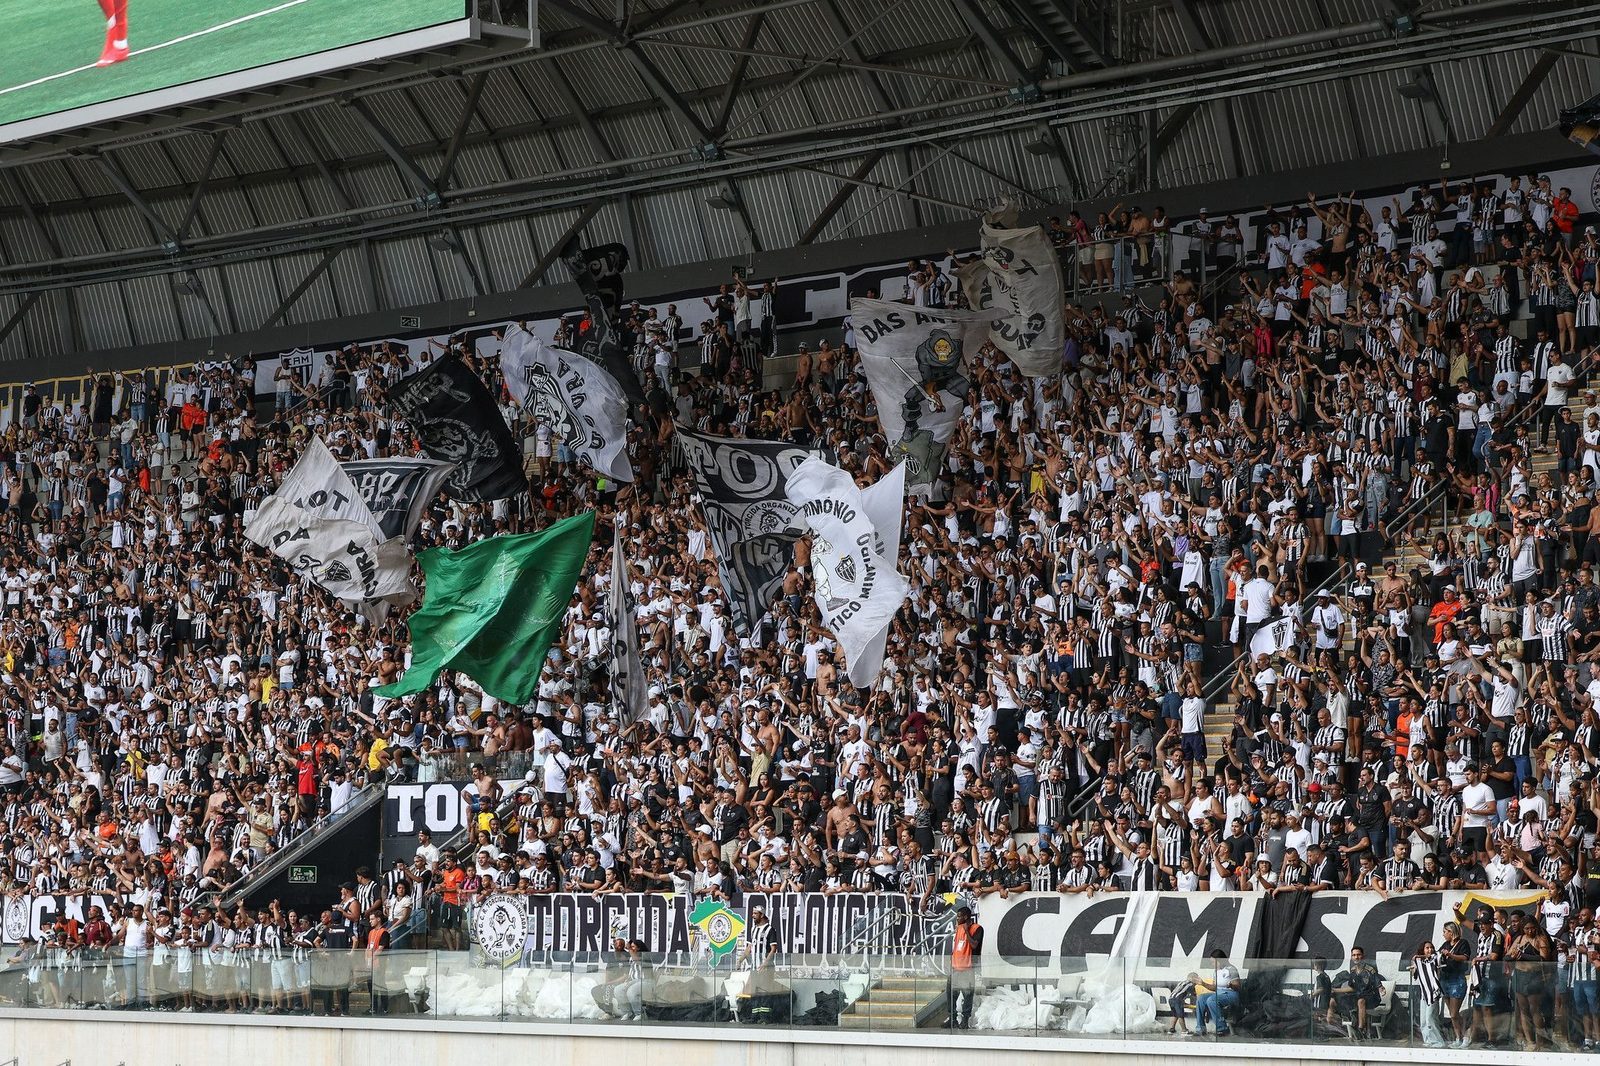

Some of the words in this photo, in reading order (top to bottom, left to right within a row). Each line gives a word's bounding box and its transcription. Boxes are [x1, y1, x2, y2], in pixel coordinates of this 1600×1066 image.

[860, 312, 905, 344] DAS
[830, 600, 862, 632] TICO
[506, 897, 527, 929] ORGANIZADA
